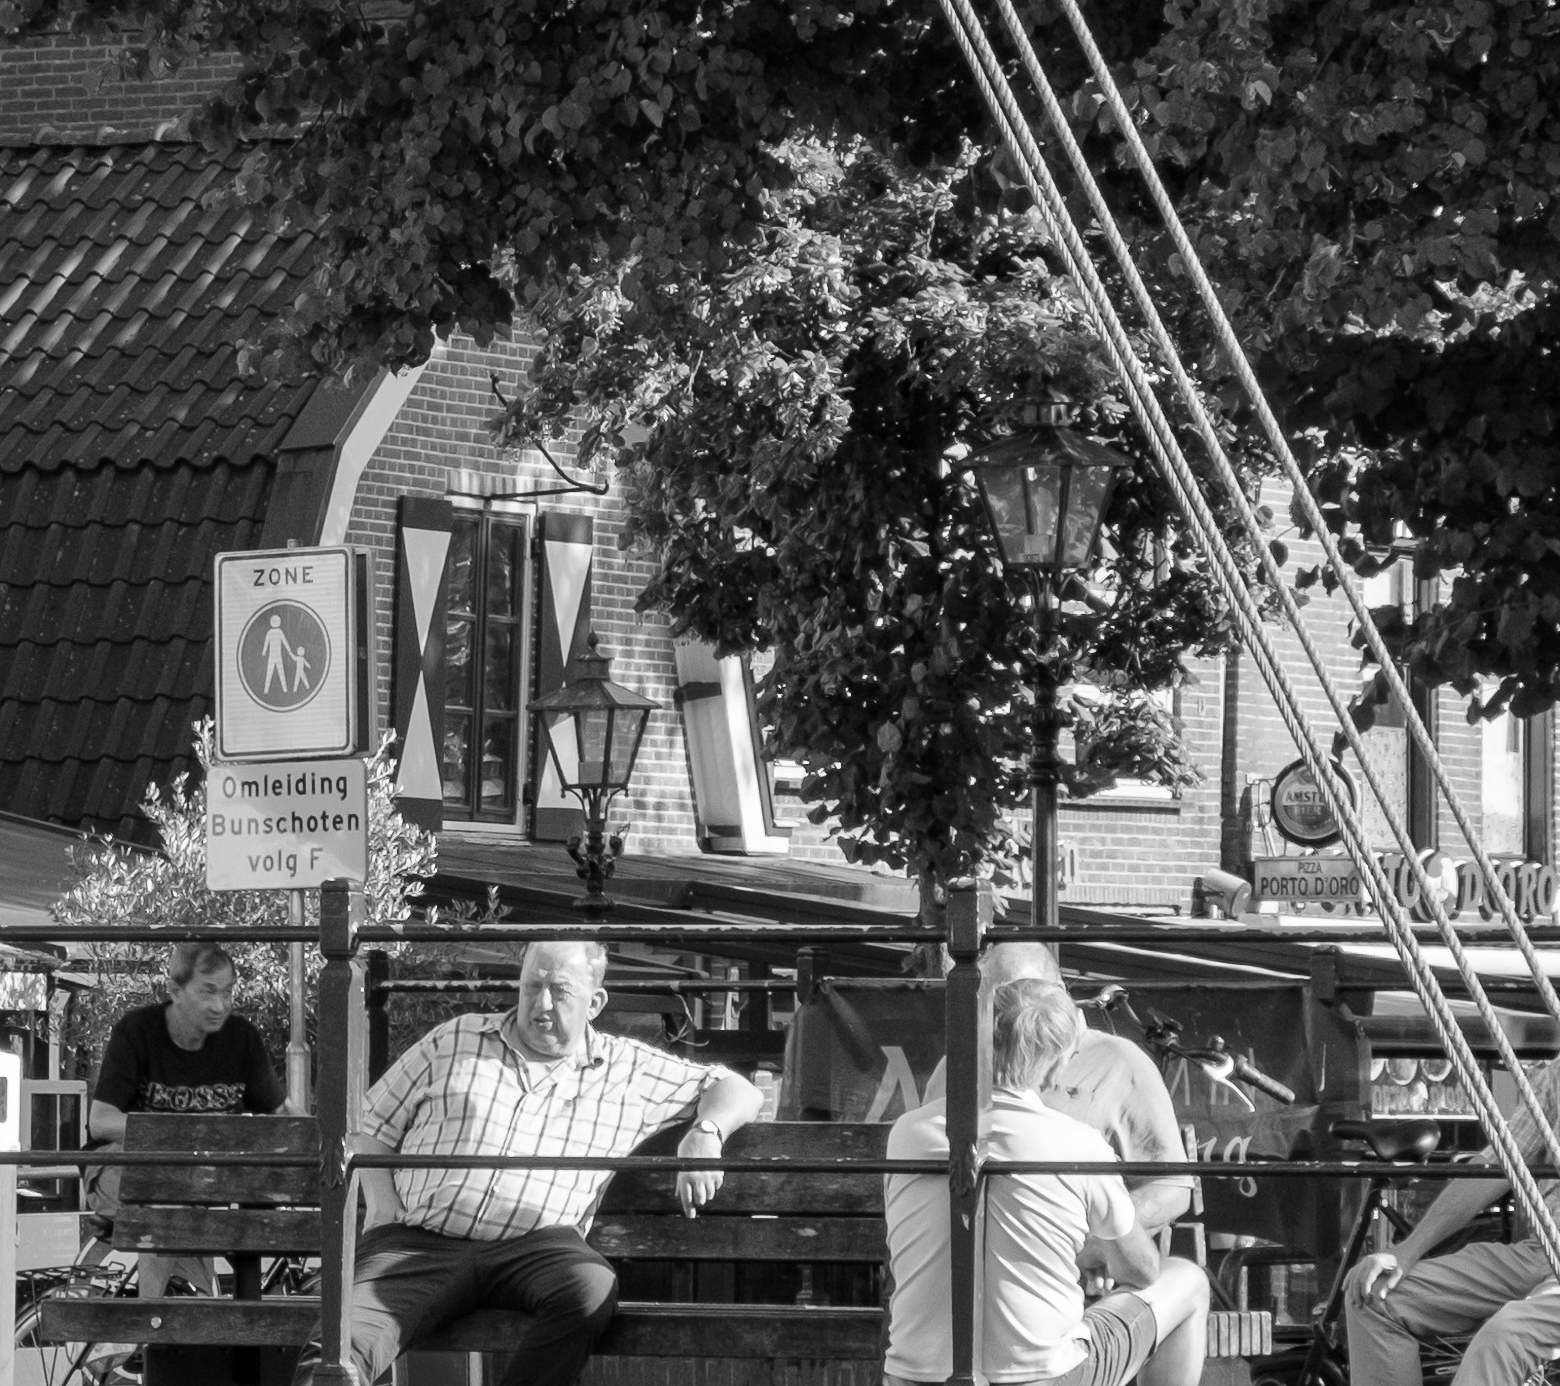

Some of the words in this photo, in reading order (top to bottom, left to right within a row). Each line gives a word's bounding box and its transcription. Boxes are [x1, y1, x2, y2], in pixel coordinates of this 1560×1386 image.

[253, 566, 315, 587] ZONE
[222, 772, 349, 801] Omleiding
[211, 812, 360, 837] Bunschoten
[248, 850, 298, 878] volg
[310, 848, 324, 871] F
[1260, 877, 1309, 895] PORTO
[1314, 877, 1360, 895] D'ORO
